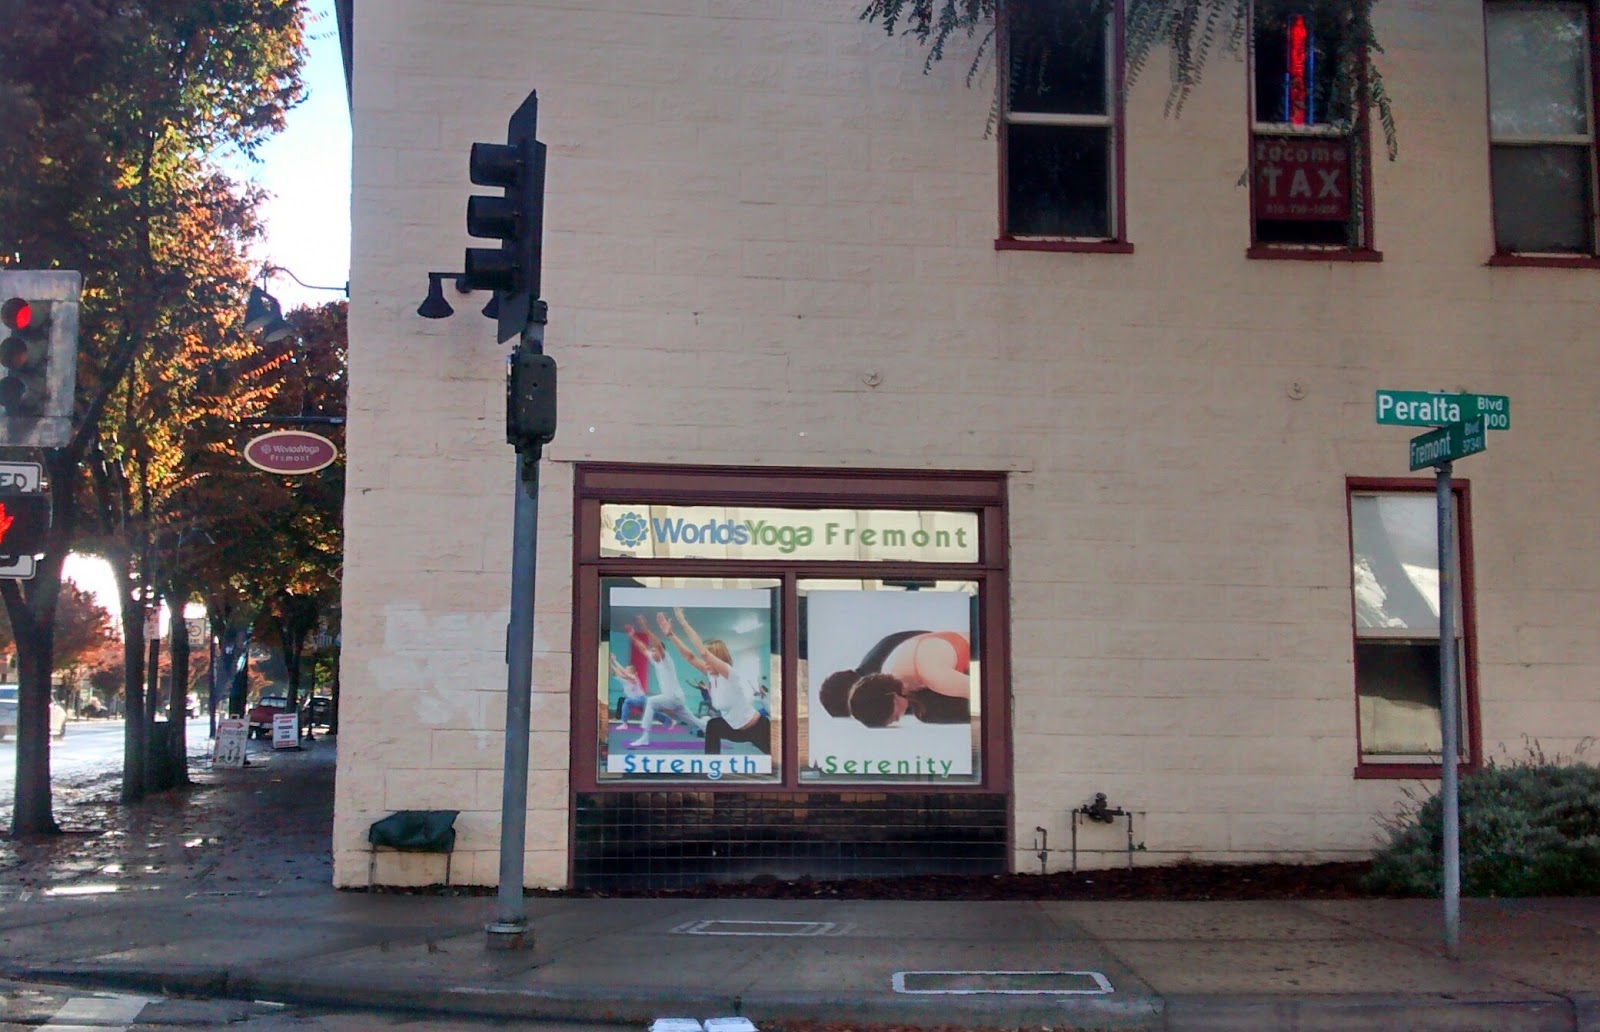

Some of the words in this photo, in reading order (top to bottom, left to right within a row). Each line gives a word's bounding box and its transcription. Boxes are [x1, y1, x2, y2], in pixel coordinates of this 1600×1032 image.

[1263, 168, 1341, 198] TAX
[1378, 395, 1460, 421] Peralta
[1477, 397, 1503, 411] Blvd
[1410, 432, 1452, 466] Fremont
[653, 517, 813, 554] WorldsYoga
[825, 522, 967, 548] Fremont
[624, 754, 756, 779] Strength
[825, 755, 953, 779] Serenity
